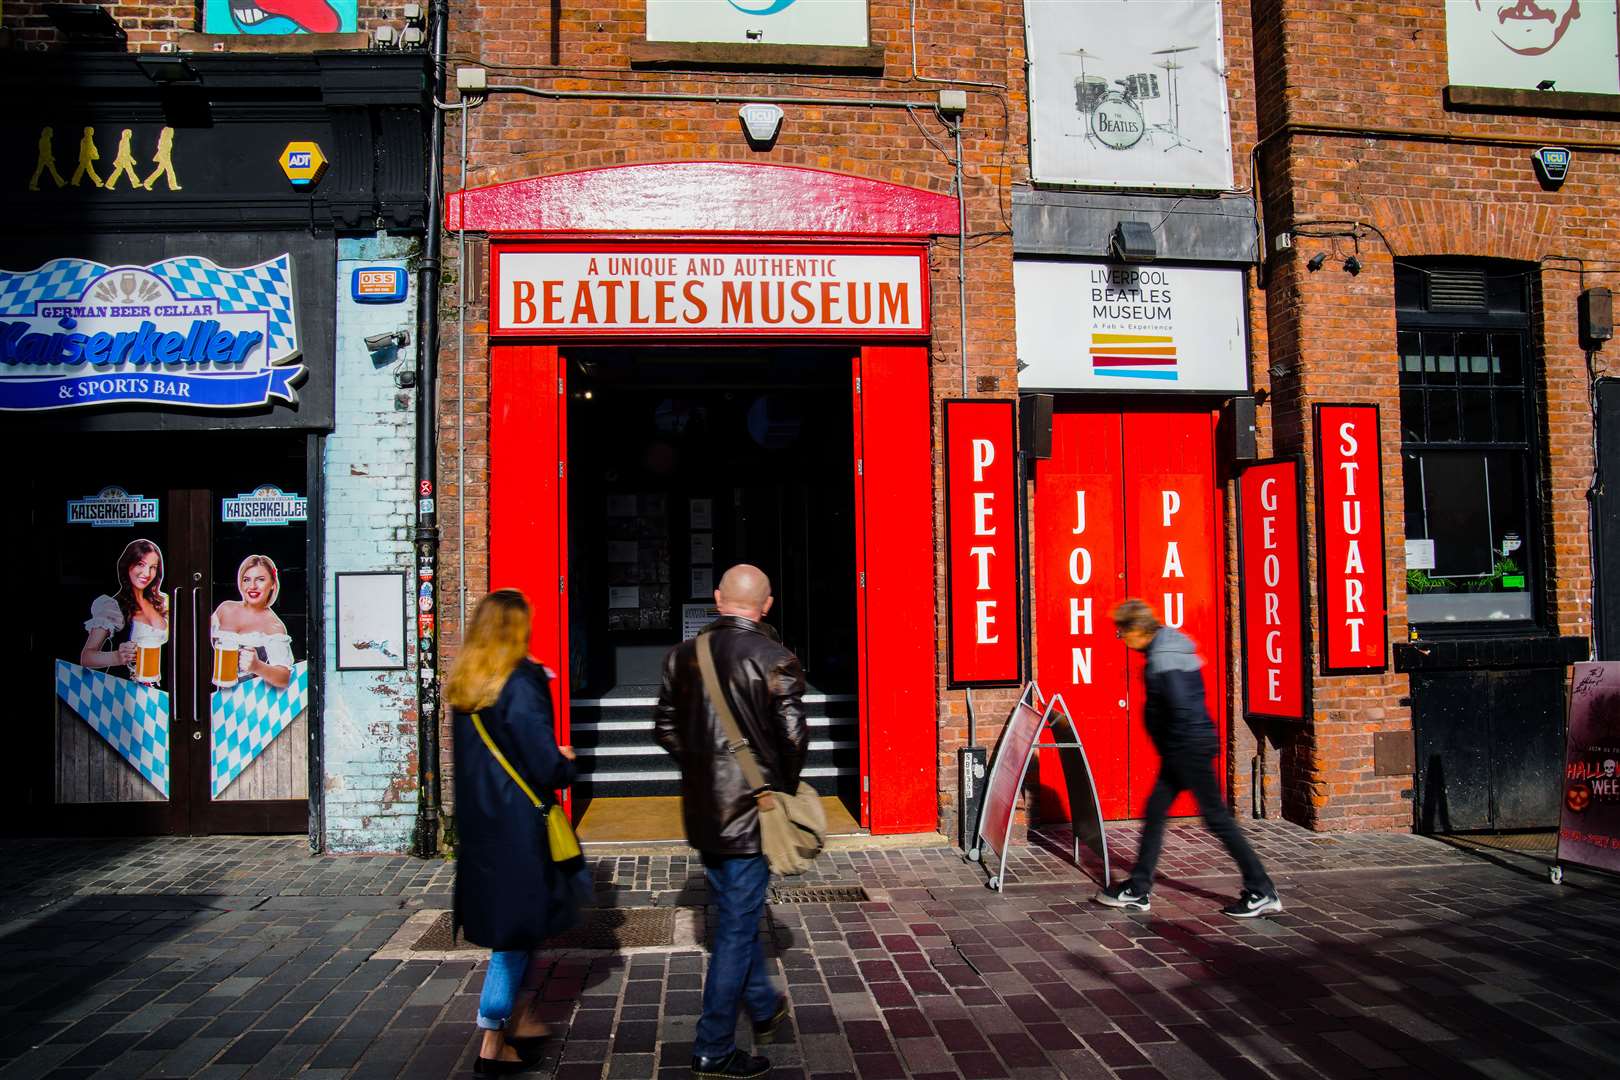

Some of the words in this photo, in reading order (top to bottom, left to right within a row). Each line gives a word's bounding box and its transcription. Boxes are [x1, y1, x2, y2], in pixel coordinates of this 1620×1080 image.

[289, 153, 312, 167] ADT
[1547, 153, 1563, 164] ICU
[587, 257, 599, 276] A
[608, 257, 678, 277] UNIQUE
[686, 257, 725, 276] AND
[733, 258, 837, 277] AUTHENTIC
[362, 274, 393, 283] OSS
[1090, 269, 1169, 286] LIVERPOOL
[512, 279, 709, 325] BEATLES
[720, 280, 910, 325] MUSEUM
[1091, 288, 1172, 304] BEATLES
[42, 305, 108, 319] GERMAN
[110, 305, 151, 318] BEER
[154, 304, 213, 317] CELLAR
[1092, 305, 1172, 321] MUSEUM
[1128, 323, 1173, 331] Experience
[58, 384, 74, 398] &
[78, 378, 149, 397] SPORTS
[152, 380, 191, 397] BAR
[71, 503, 156, 519] KAISERKELLER
[969, 439, 999, 644] PETE
[1339, 422, 1365, 653] STUART
[1161, 490, 1185, 629] PAU
[1068, 490, 1093, 685] JOHN
[1260, 478, 1282, 702] GEORGE
